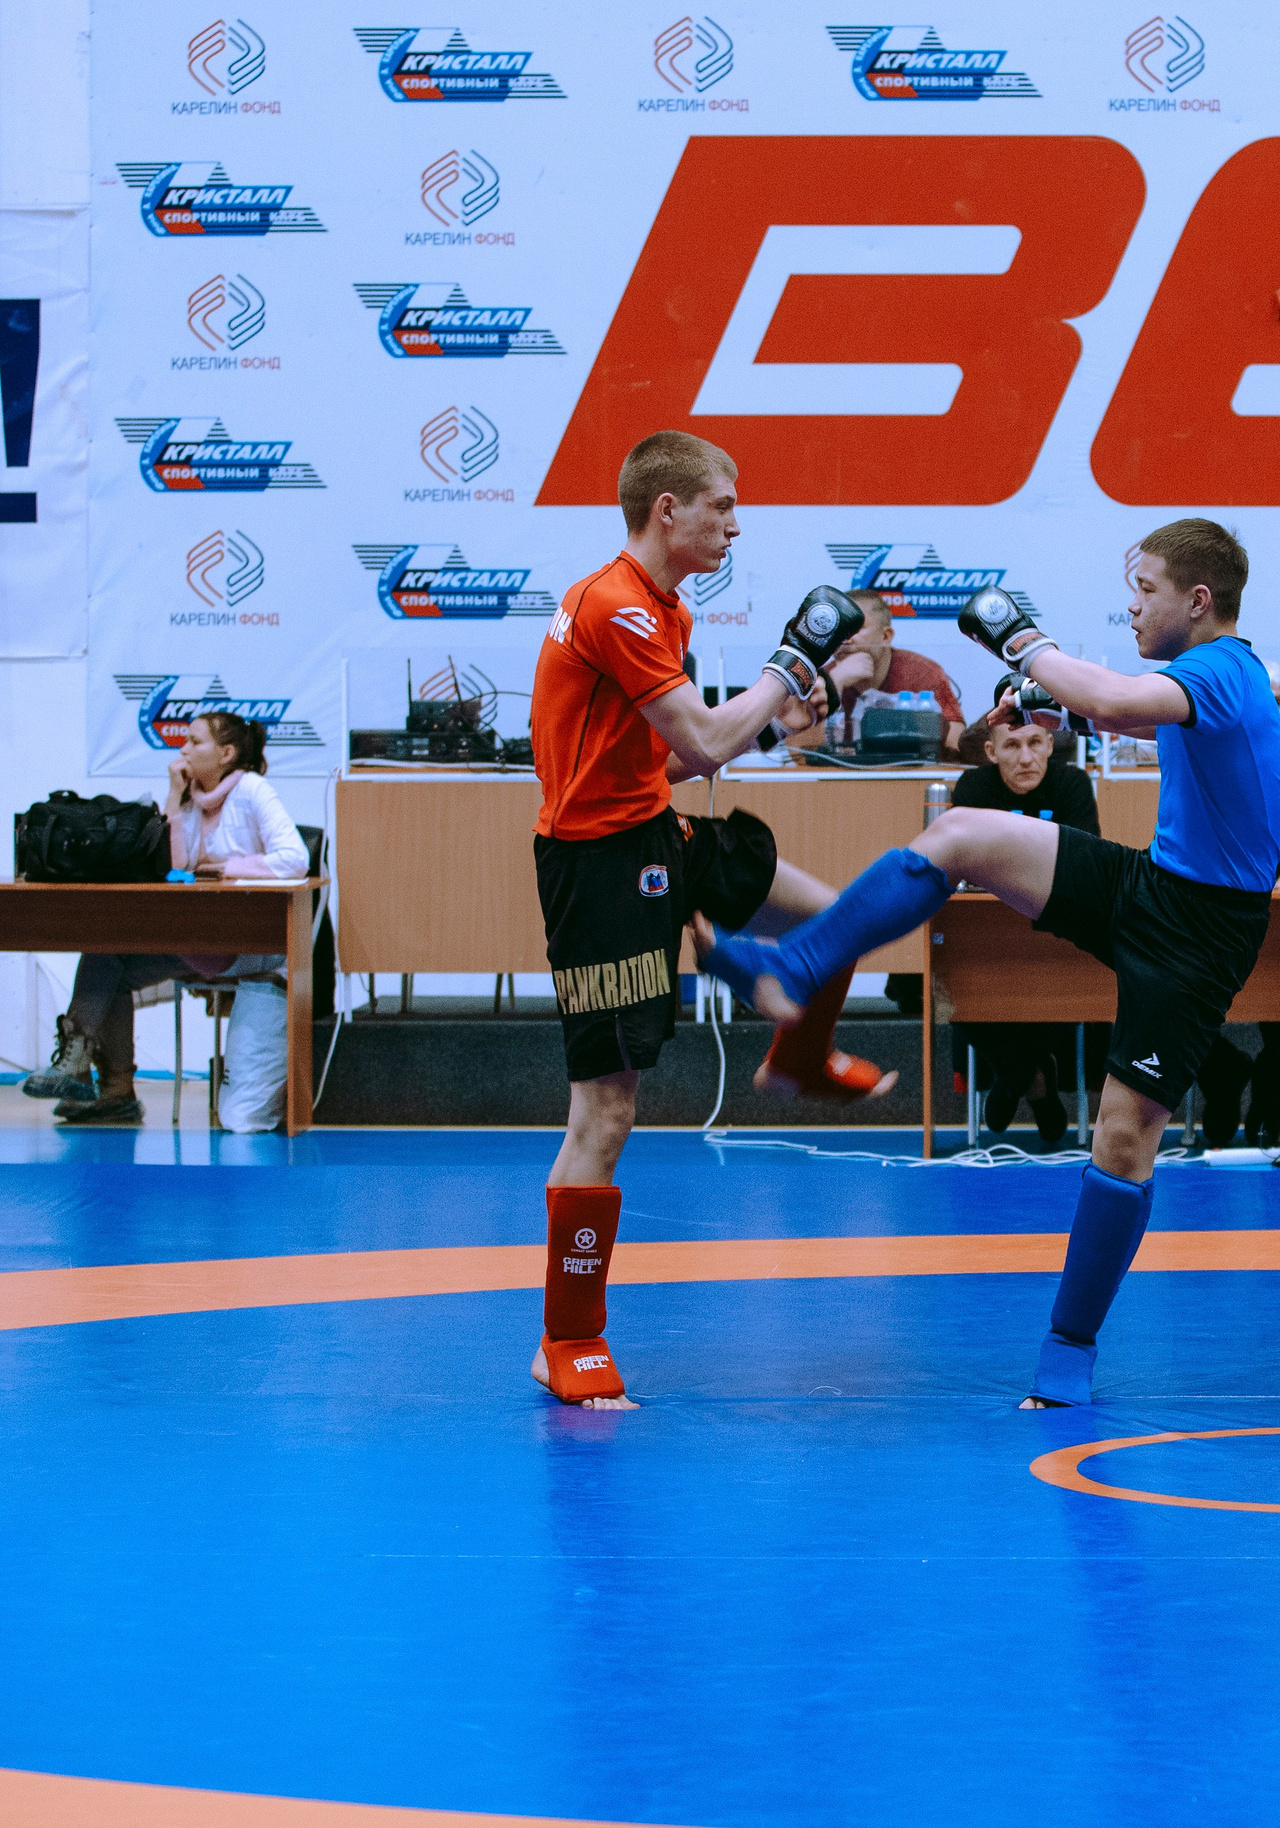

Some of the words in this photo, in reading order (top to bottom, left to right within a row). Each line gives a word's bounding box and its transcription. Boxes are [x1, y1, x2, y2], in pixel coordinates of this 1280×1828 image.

[401, 54, 527, 71] КРИСТАЛЛ
[875, 52, 1001, 69] КРИСТАЛЛ
[401, 78, 499, 90] СПОРТИВНЫЙ
[875, 77, 973, 89] СПОРТИВНЫЙ
[171, 101, 237, 115] КАРЕЛИН
[240, 101, 280, 116] ФОНД
[638, 99, 704, 112] КАРЕЛИН
[708, 99, 748, 113] ФОНД
[1109, 98, 1176, 112] КАРЕЛИН
[1180, 98, 1220, 113] ФОНД
[162, 188, 288, 205] КРИСТАЛЛ
[162, 212, 260, 224] СПОРТИВНЫЙ
[405, 232, 471, 246] КАРЕЛИН
[474, 232, 514, 247] ФОНД
[401, 310, 527, 327] КРИСТАЛЛ
[401, 334, 499, 346] СПОРТИВНЫЙ
[171, 356, 237, 370] КАРЕЛИН
[240, 356, 280, 371] ФОНД
[162, 444, 288, 461] КРИСТАЛЛ
[162, 468, 260, 480] СПОРТИВНЫЙ
[404, 489, 470, 502] КАРЕЛИН
[474, 489, 513, 503] ФОНД
[400, 571, 526, 588] КРИСТАЛЛ
[874, 571, 1000, 588] КРИСТАЛЛ
[400, 595, 498, 607] СПОРТИВНЫЙ
[170, 613, 235, 626] КАРЕЛИН
[239, 613, 279, 627] ФОНД
[707, 612, 747, 625] ФОНД
[554, 949, 671, 1015] PANKRATION
[1131, 1060, 1163, 1079] DEMIX
[562, 1257, 602, 1266] GREEN
[563, 1264, 596, 1274] HILL
[573, 1354, 610, 1366] GREEN
[576, 1360, 608, 1373] HILL
